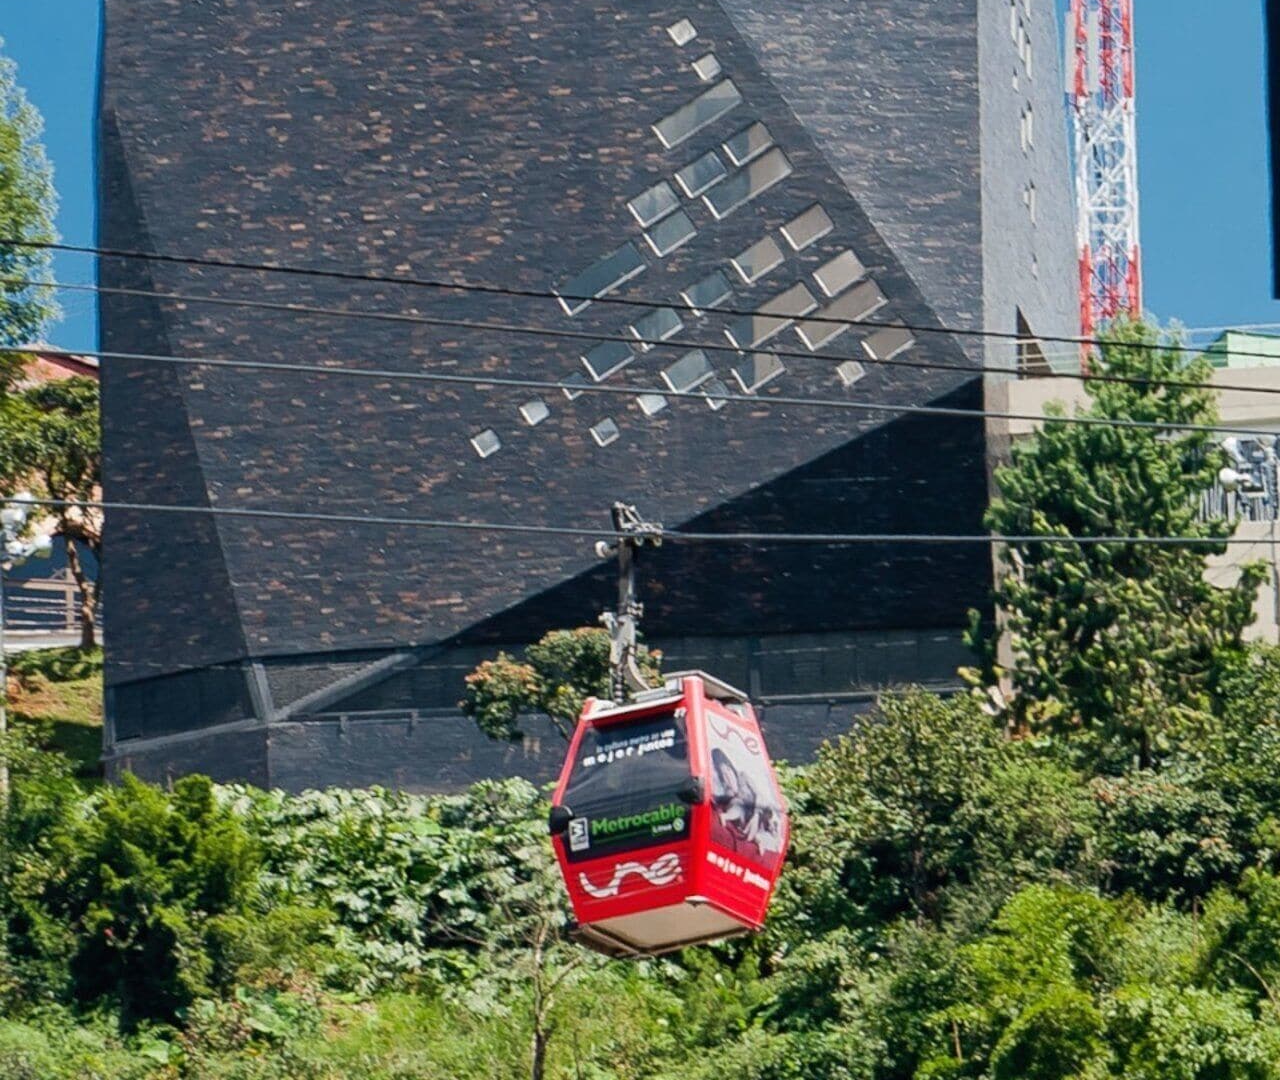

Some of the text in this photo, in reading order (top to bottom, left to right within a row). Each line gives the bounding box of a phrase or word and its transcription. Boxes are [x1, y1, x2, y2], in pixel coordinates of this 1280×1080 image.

[583, 738, 675, 767] mejor juntos
[591, 803, 685, 835] Metrocable
